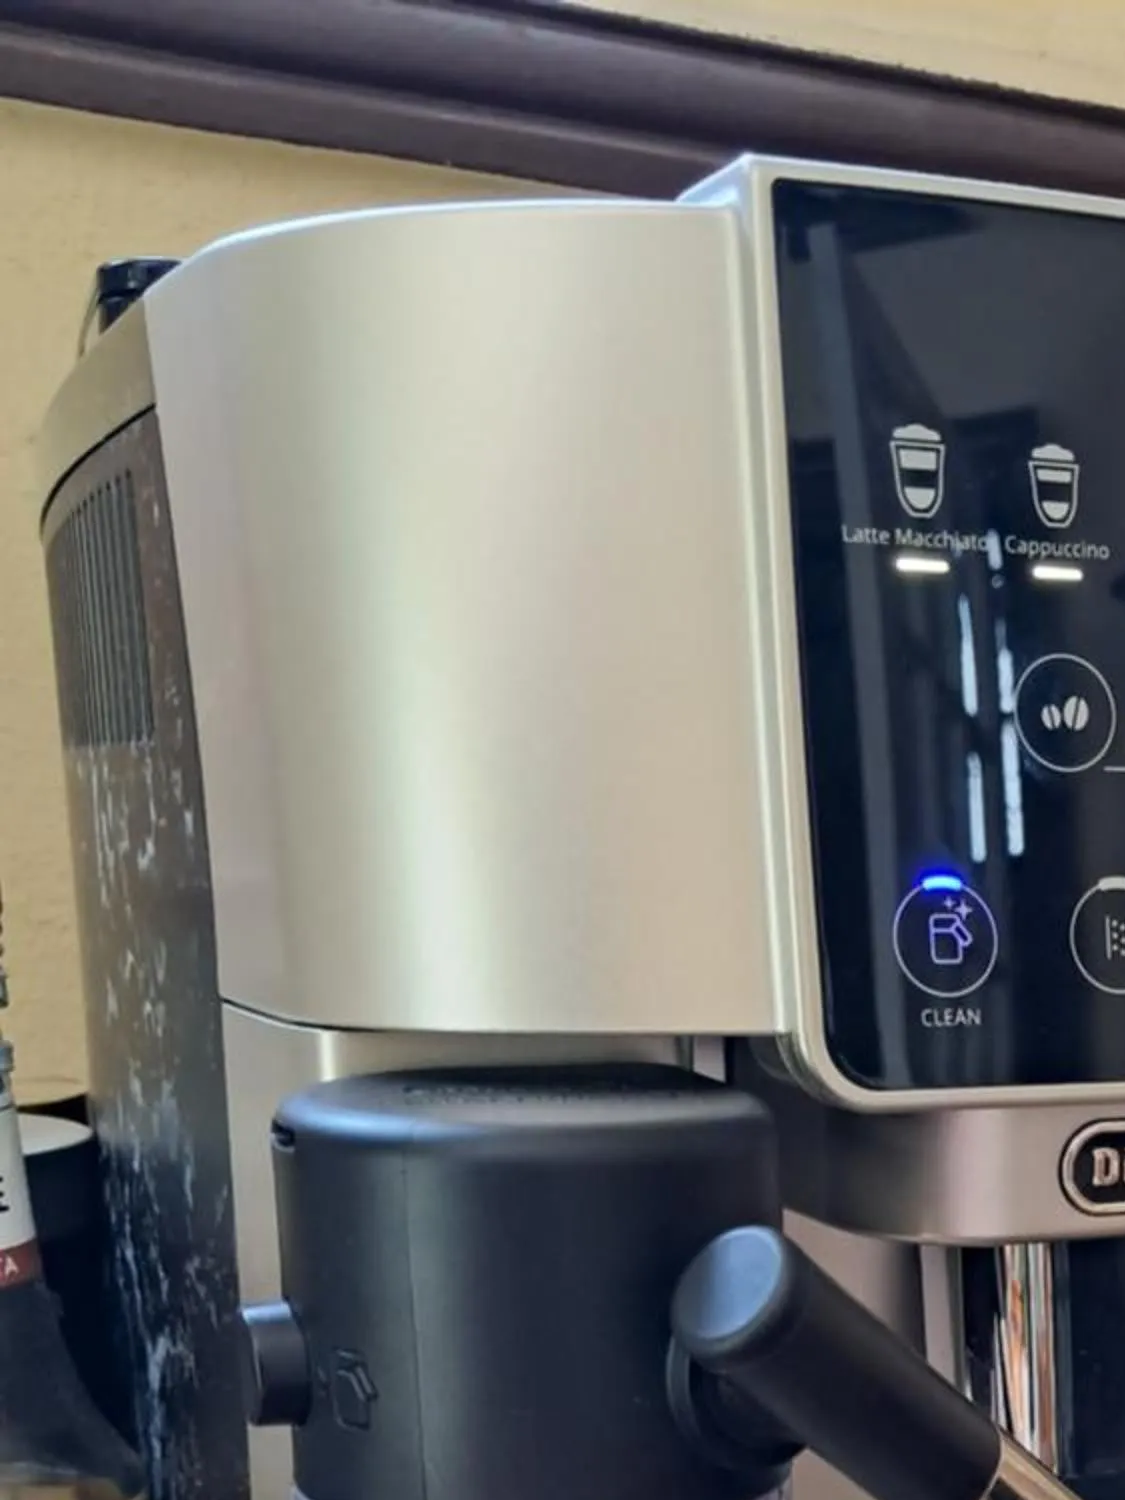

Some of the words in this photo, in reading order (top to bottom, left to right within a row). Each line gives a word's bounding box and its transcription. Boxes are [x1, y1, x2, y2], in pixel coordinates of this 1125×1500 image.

[841, 523, 890, 545] Latte
[894, 527, 988, 552] Macchiato
[1004, 535, 1110, 560] Cappuccino
[920, 1007, 982, 1028] CLEAN
